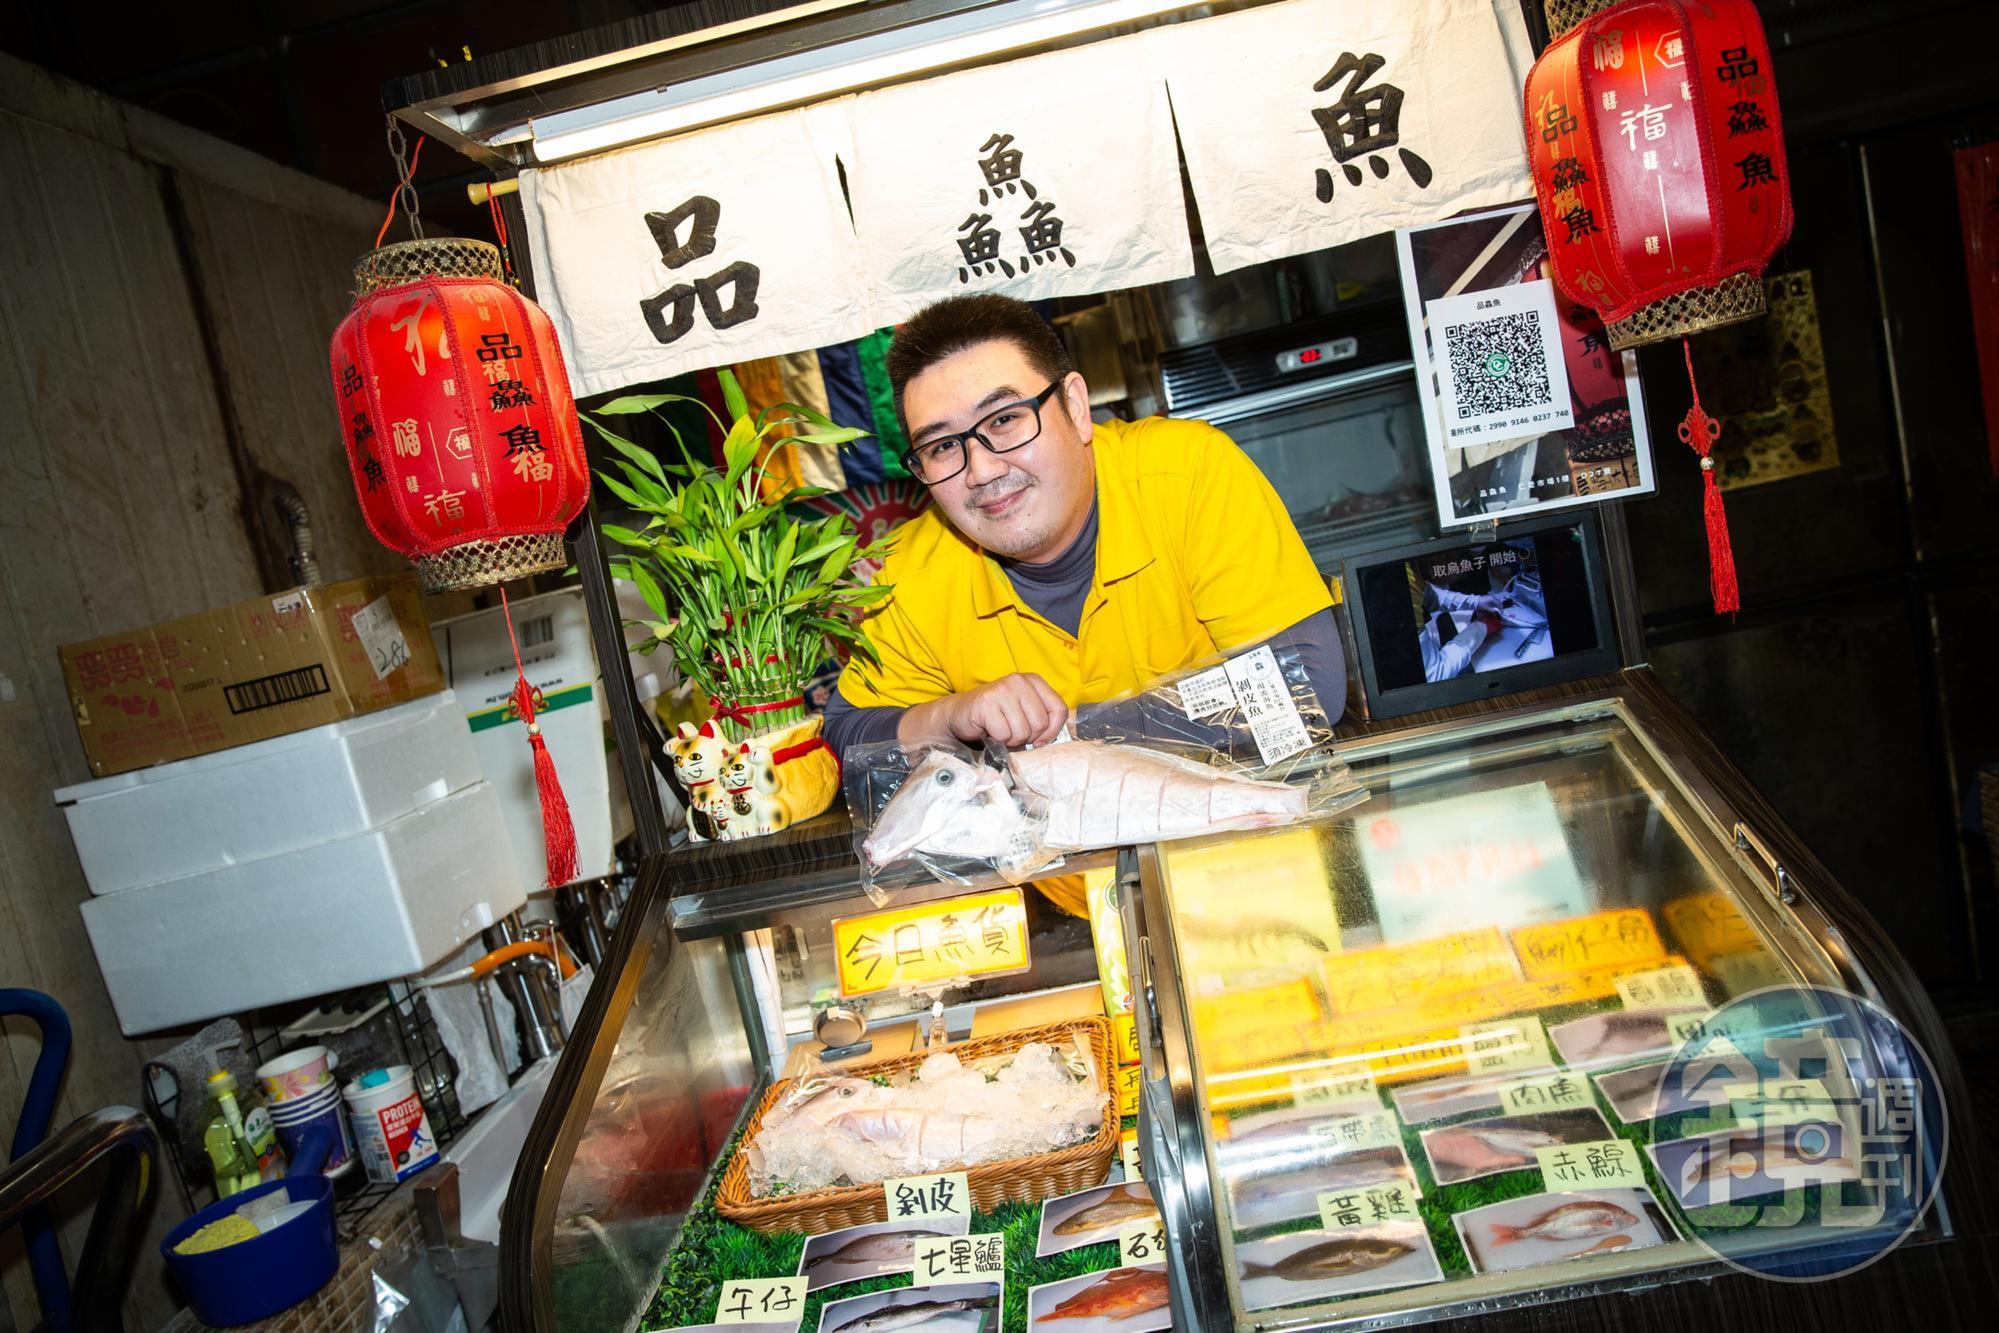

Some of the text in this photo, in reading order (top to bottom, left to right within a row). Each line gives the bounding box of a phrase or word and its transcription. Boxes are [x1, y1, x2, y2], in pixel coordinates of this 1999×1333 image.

[1620, 103, 1673, 152] 福
[1488, 421, 1508, 431] 2990
[1510, 416, 1530, 427] 9146
[1532, 412, 1551, 424] 0237
[1554, 409, 1570, 420] 740
[511, 450, 553, 484] 福
[424, 490, 466, 528] 福
[1489, 551, 1517, 567] 開始
[846, 905, 1013, 981] 今日魚貨
[921, 1239, 1003, 1277] 七星鱸
[724, 1285, 798, 1320] 午仔
